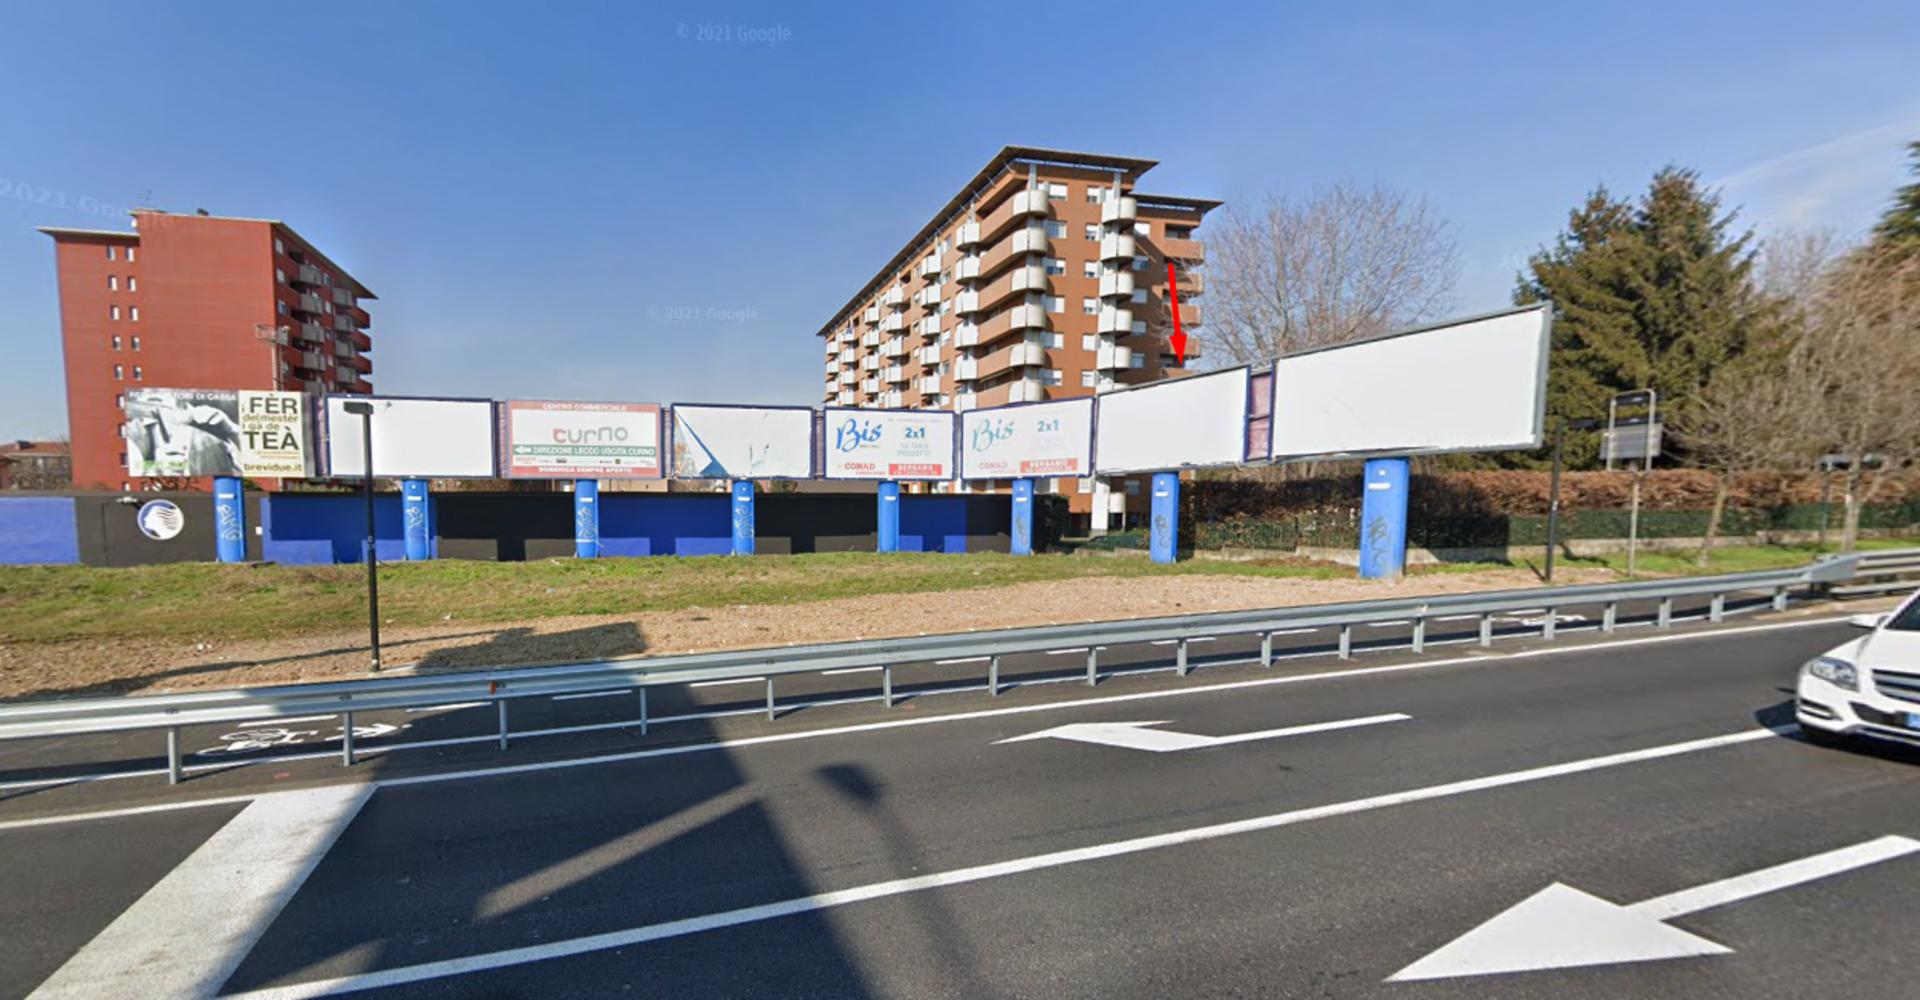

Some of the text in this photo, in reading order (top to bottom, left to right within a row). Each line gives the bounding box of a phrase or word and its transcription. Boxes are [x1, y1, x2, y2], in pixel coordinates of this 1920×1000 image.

[249, 393, 298, 414] FÈR
[265, 422, 280, 431] de
[905, 426, 926, 439] 2x1
[1036, 419, 1060, 433] 2x1
[242, 426, 300, 450] TEÀ
[552, 426, 629, 444] curno
[835, 418, 882, 453] Bis
[971, 418, 1015, 453] Bis
[532, 446, 573, 455] DIREZIONE
[574, 447, 600, 456] LECCO
[601, 448, 627, 456] USCITA
[243, 462, 303, 472] brevidue.it
[844, 462, 876, 470] CONAD
